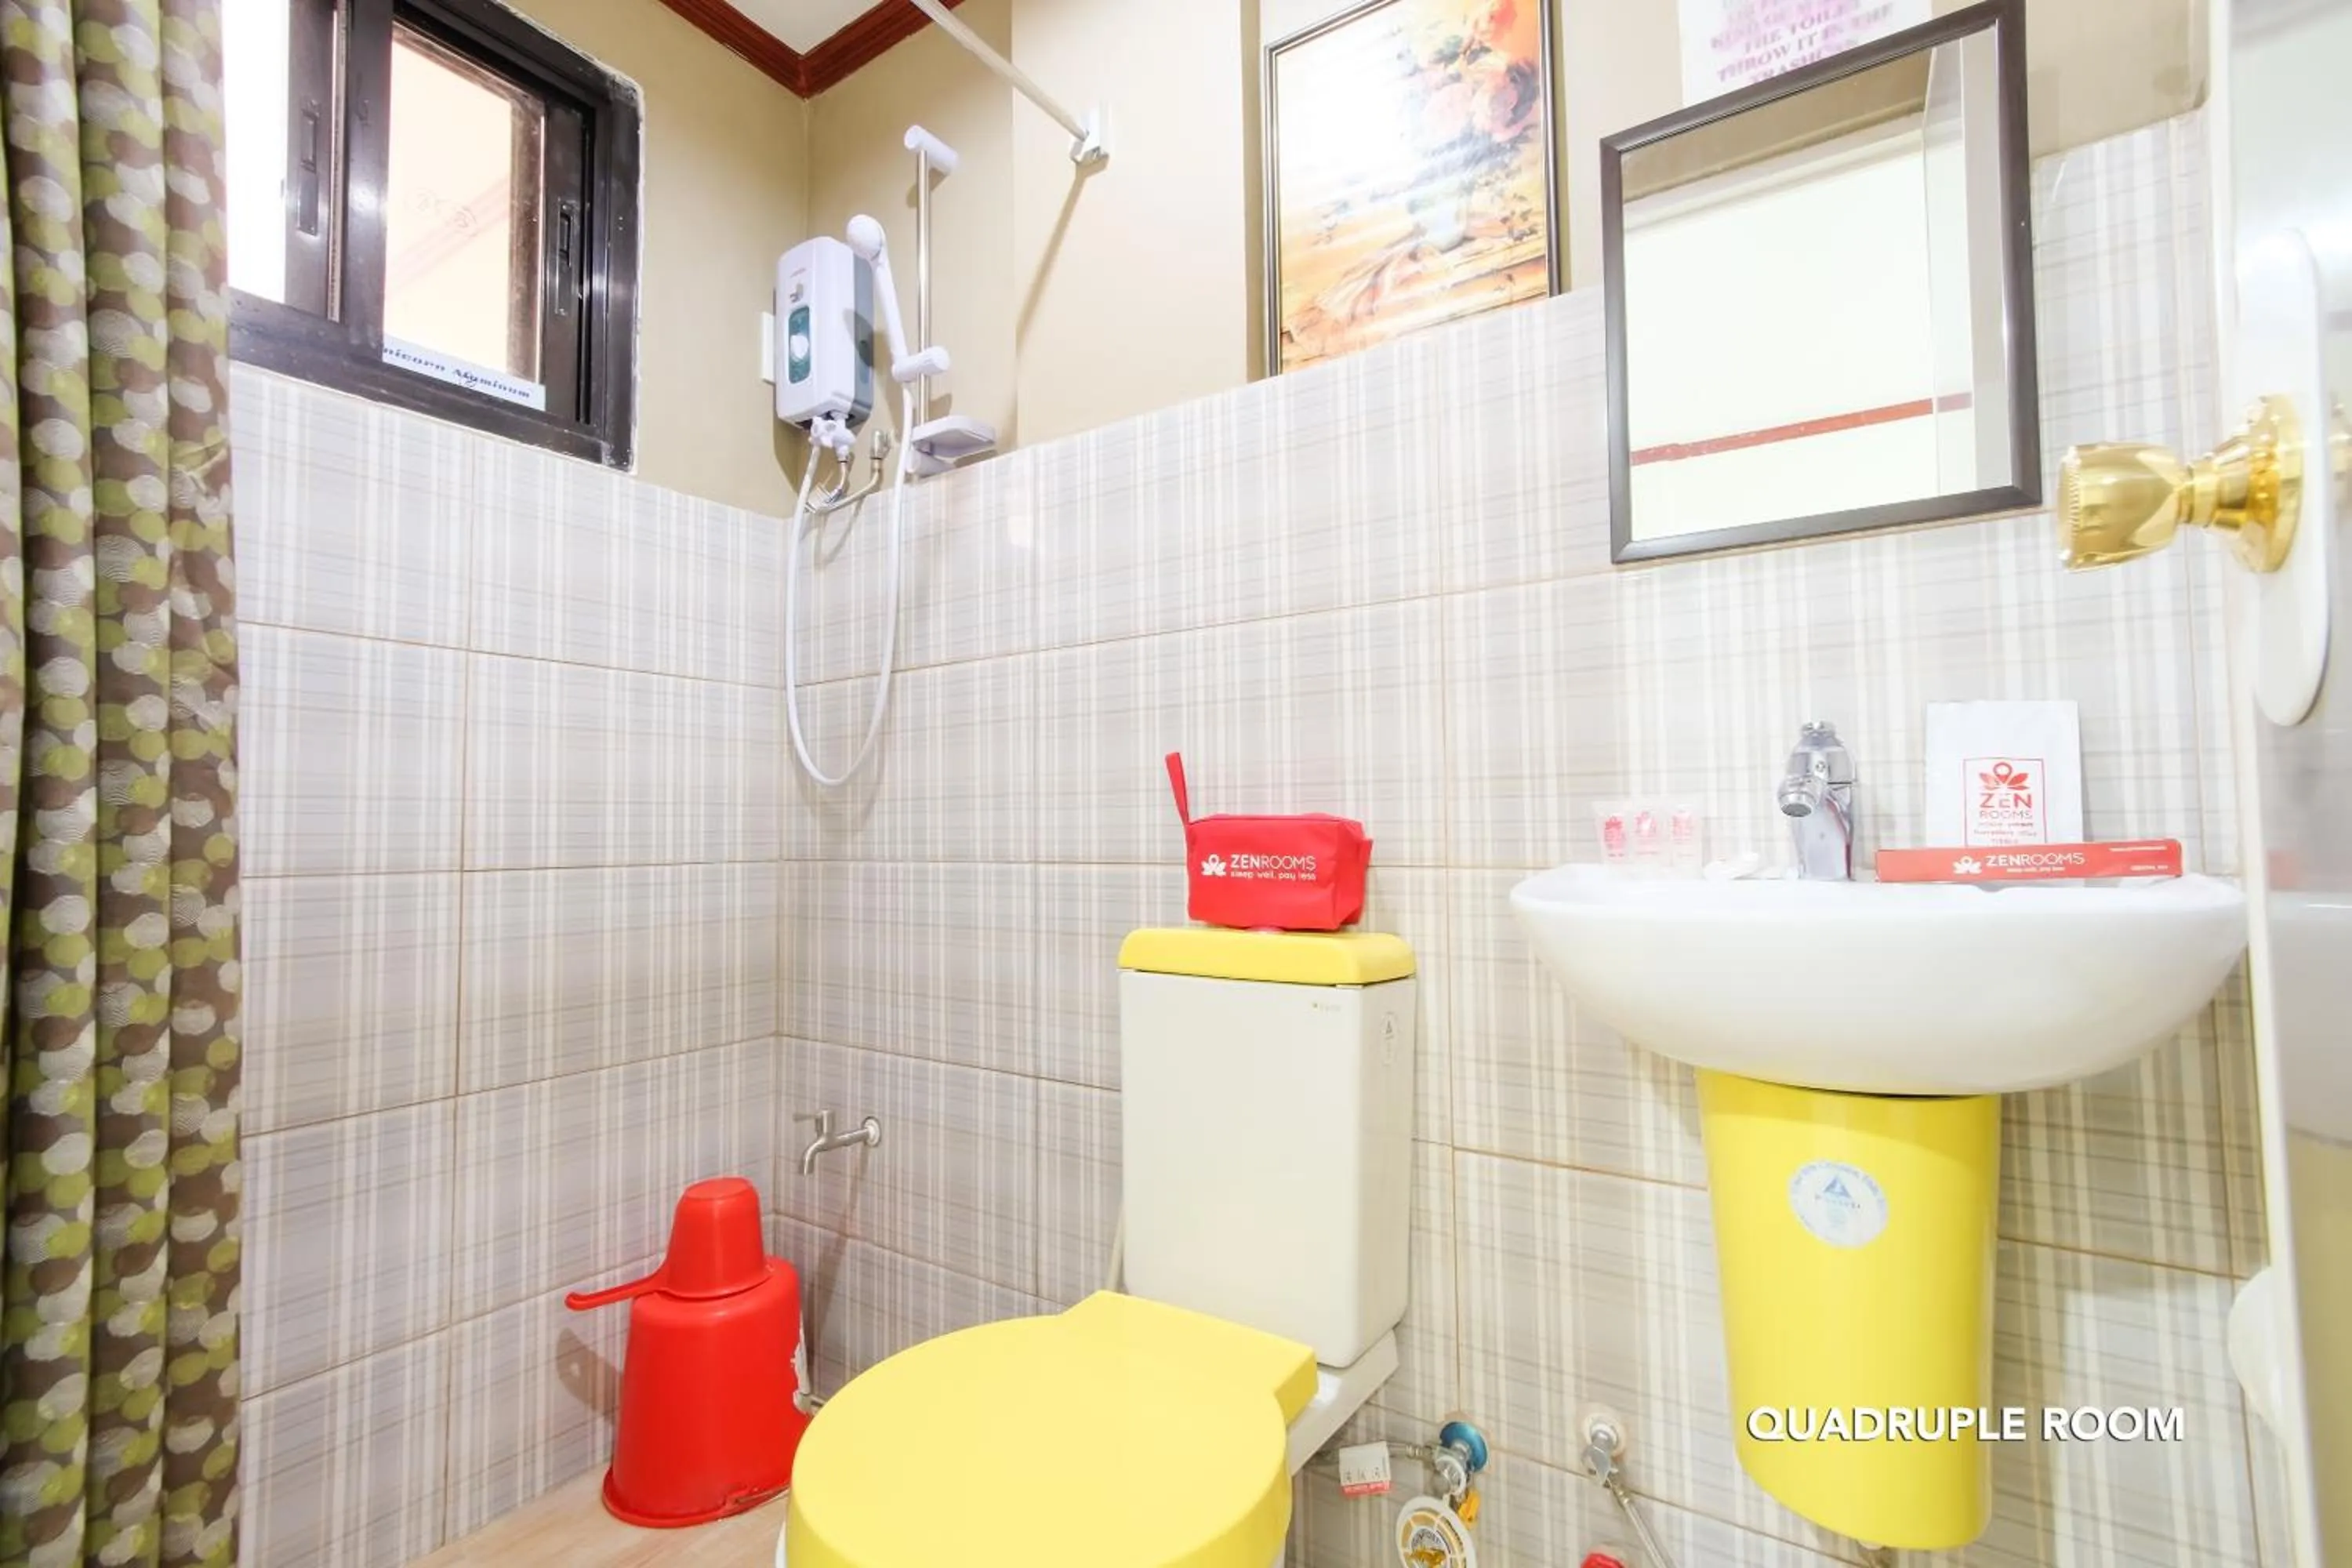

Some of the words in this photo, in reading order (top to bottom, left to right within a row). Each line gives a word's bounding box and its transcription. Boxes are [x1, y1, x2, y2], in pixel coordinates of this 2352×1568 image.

[1717, 44, 1791, 82] THROW
[1796, 31, 1819, 51] IT
[1980, 793, 2032, 808] ZEN
[1980, 810, 2033, 820] ROOMS
[1230, 854, 1316, 871] ZENROOMS
[1986, 852, 2085, 867] ZENROOMS
